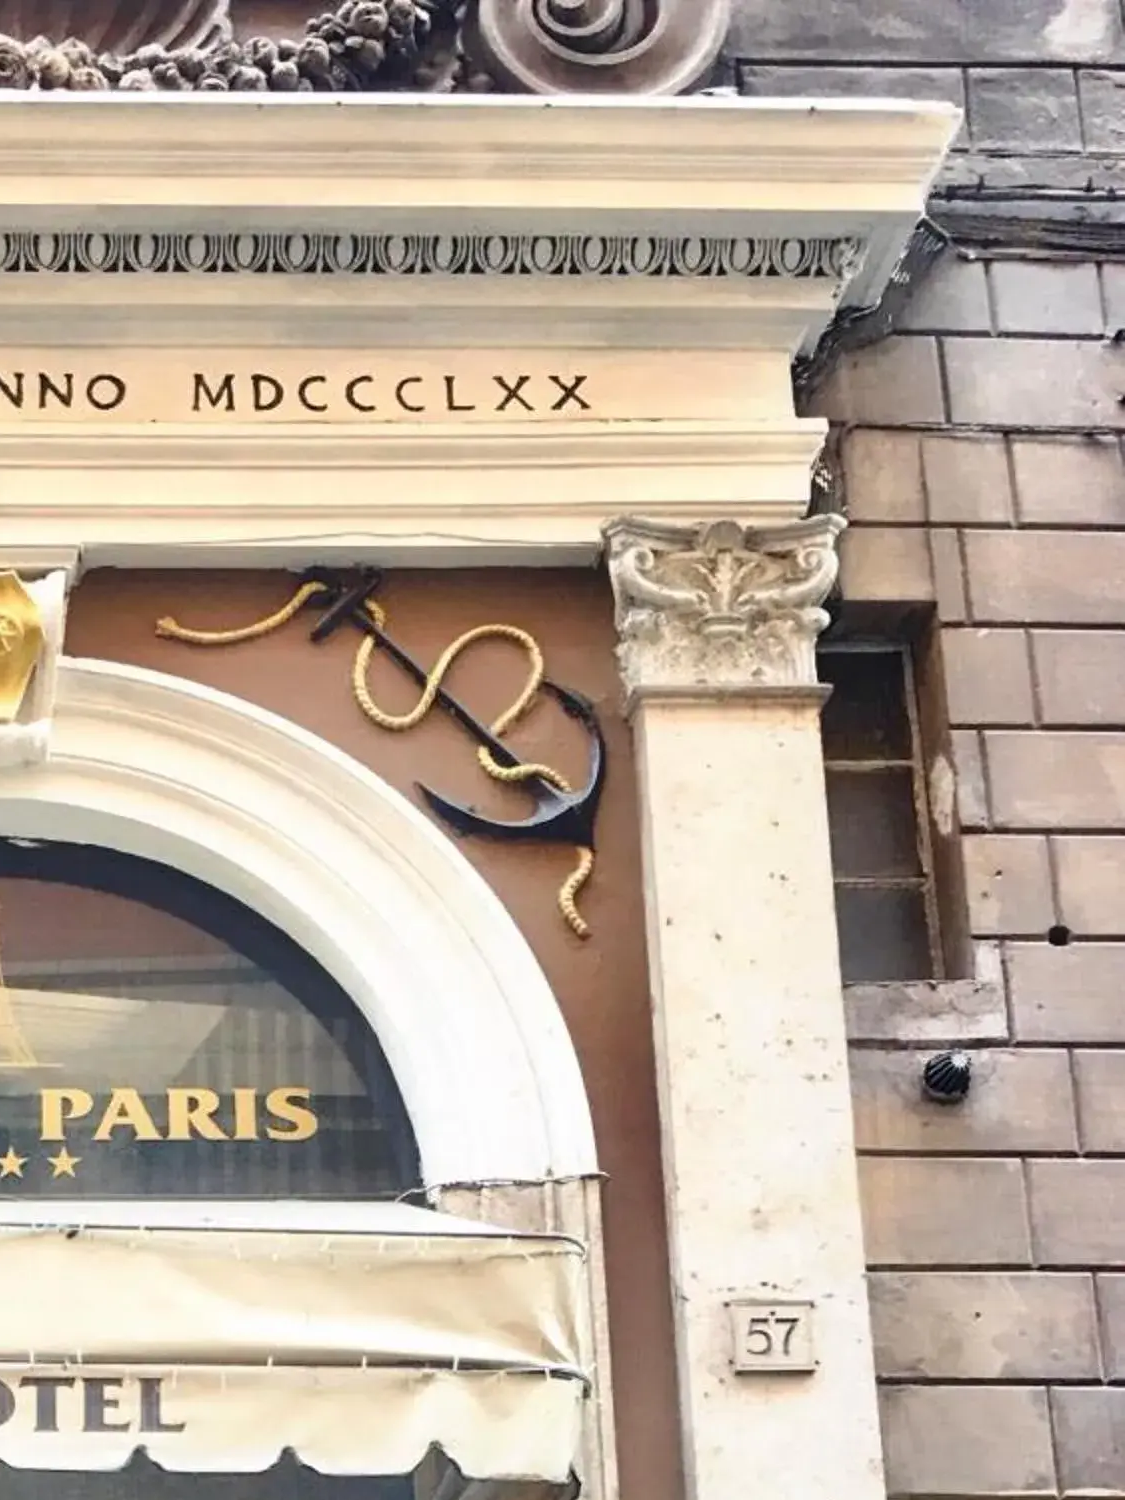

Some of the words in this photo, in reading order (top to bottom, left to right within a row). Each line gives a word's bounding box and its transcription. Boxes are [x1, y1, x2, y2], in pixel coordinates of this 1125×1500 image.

[192, 374, 593, 412] MDCCCLXX
[39, 1087, 319, 1142] PARIS
[746, 1317, 800, 1356] 57
